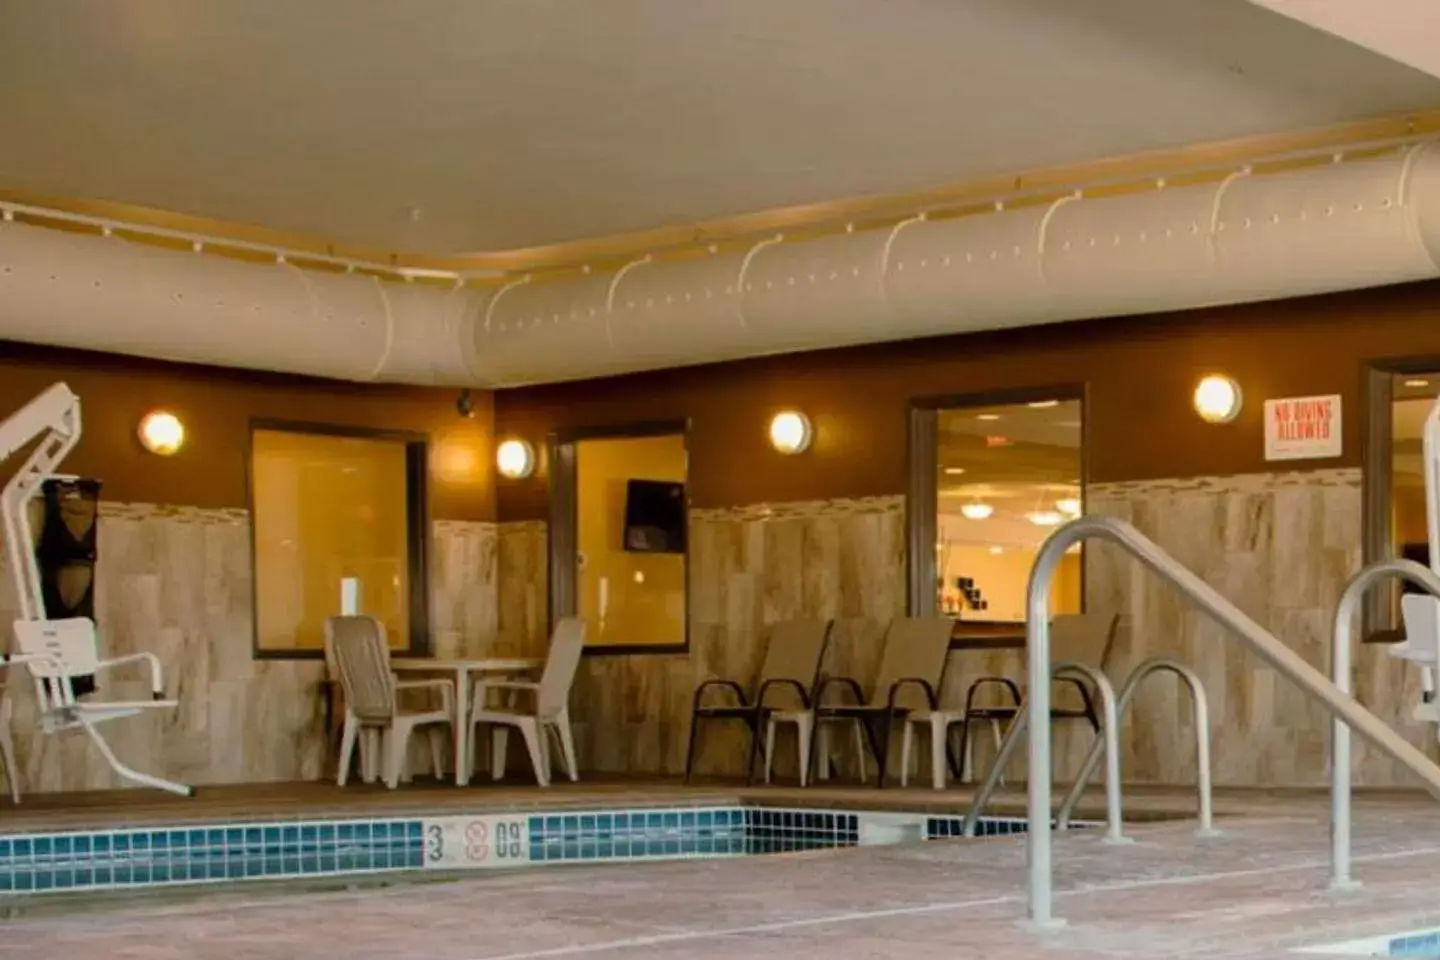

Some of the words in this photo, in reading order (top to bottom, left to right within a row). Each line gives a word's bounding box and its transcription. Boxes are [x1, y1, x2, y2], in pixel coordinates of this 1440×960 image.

[1275, 401, 1289, 421] NO
[1294, 400, 1332, 420] DIVING
[1277, 422, 1330, 440] ALLOWED
